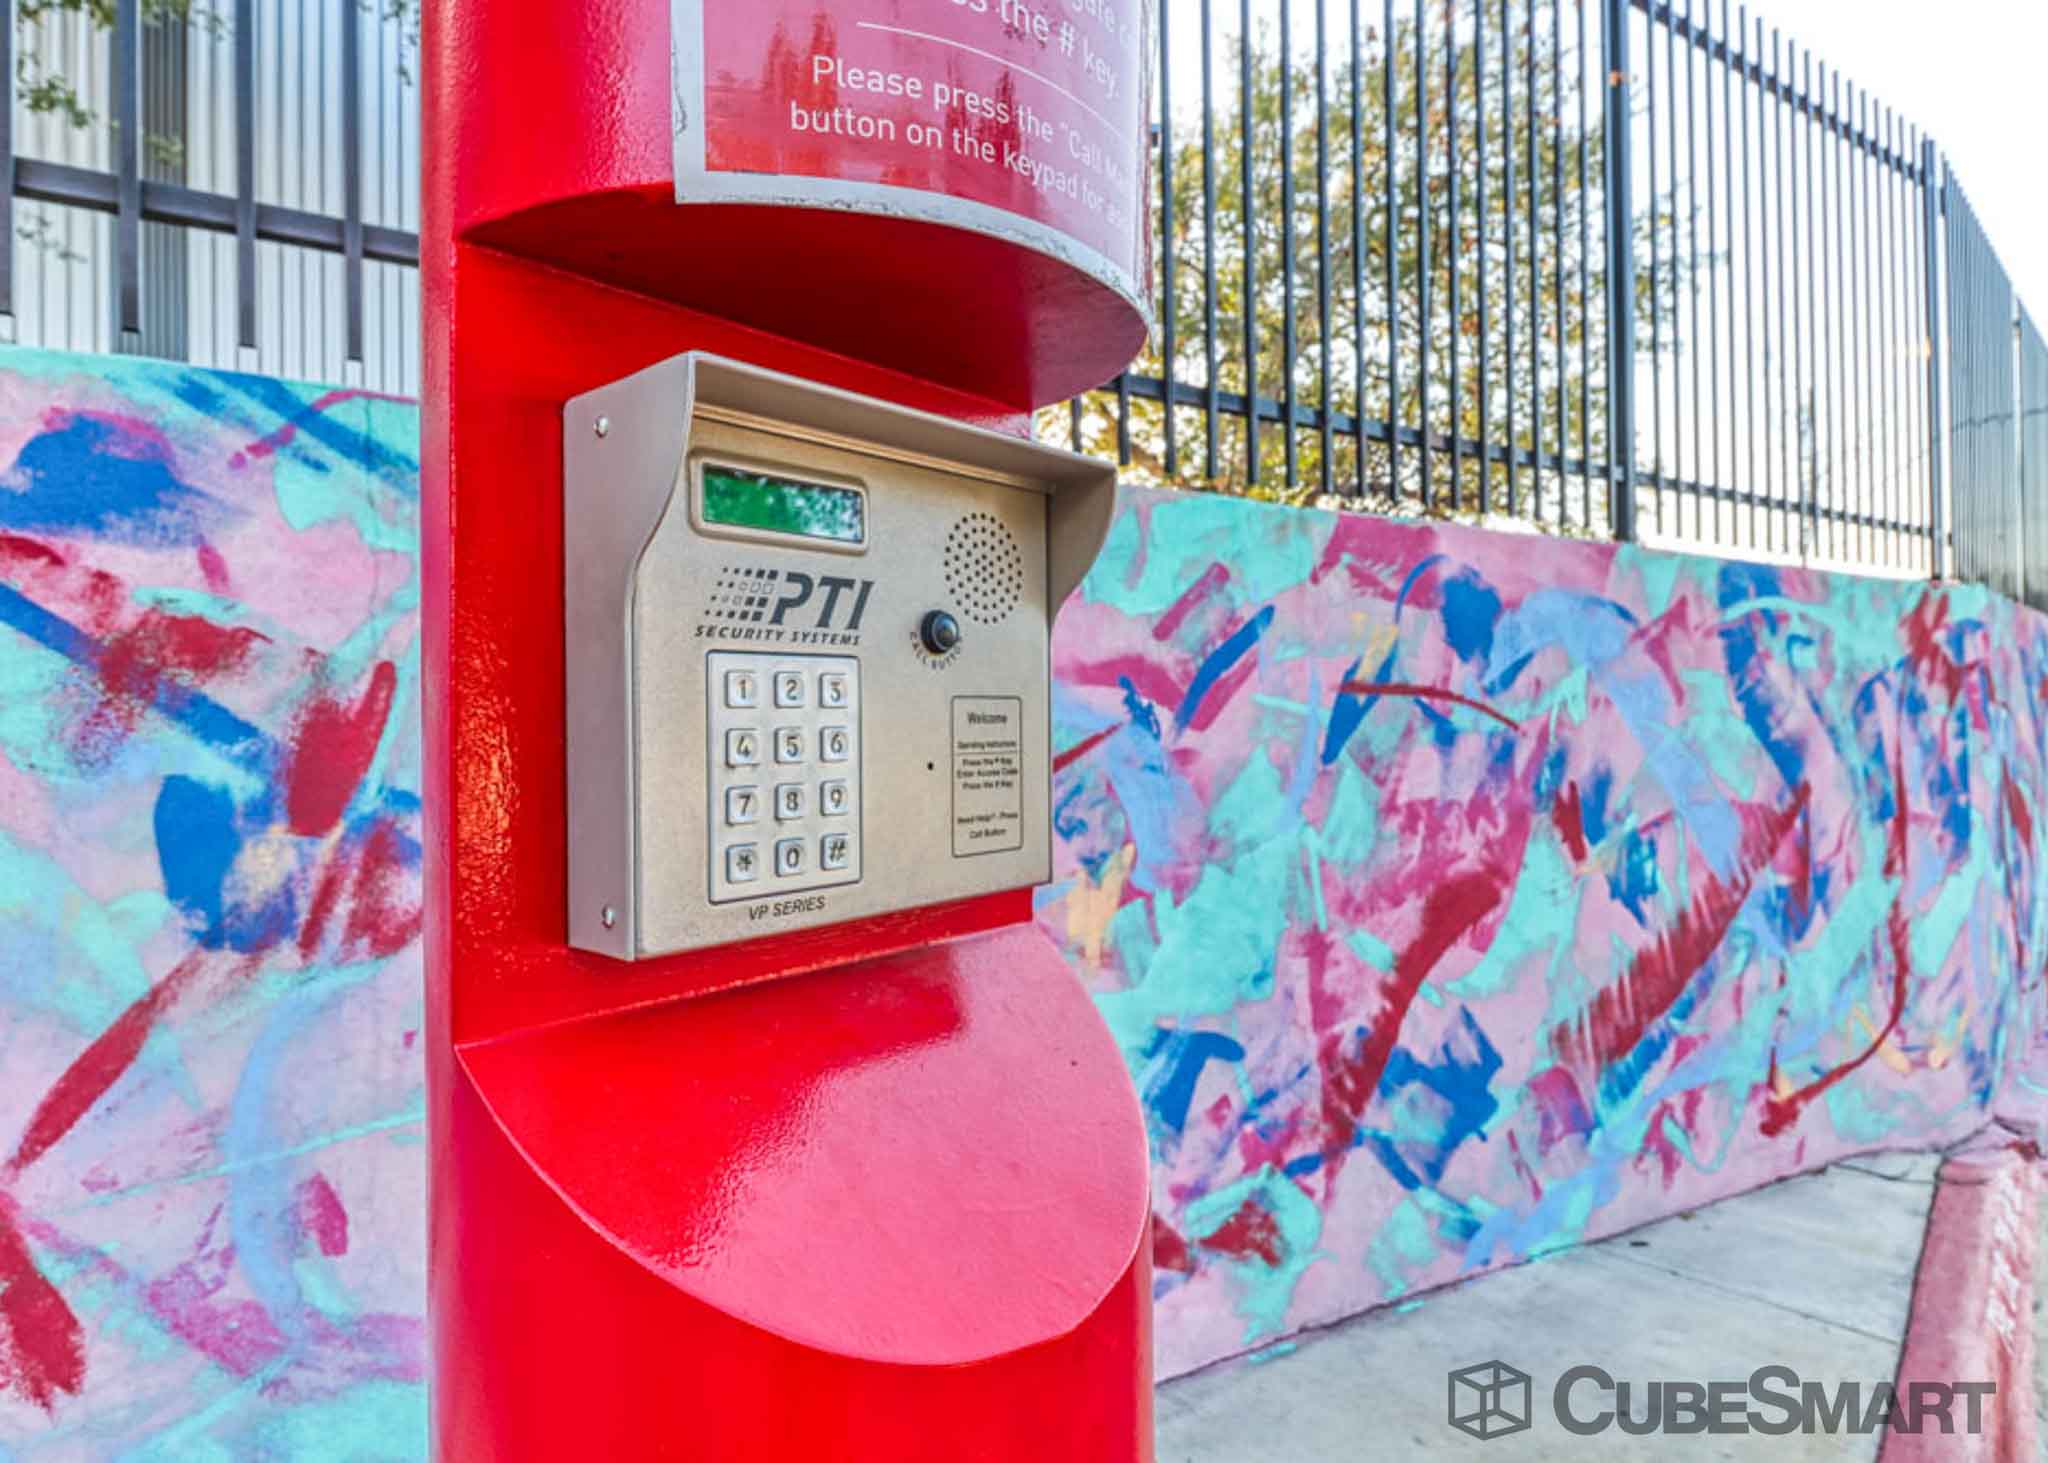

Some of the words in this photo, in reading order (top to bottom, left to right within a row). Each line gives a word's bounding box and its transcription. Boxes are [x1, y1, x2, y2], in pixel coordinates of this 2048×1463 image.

[812, 56, 922, 99] Please
[934, 82, 1010, 124] press
[1017, 104, 1054, 143] the
[790, 101, 895, 142] button
[906, 122, 943, 149] on
[952, 126, 996, 163] the
[1003, 141, 1079, 200] keypad
[769, 572, 875, 630] PTI
[695, 624, 784, 643] SECURITY
[791, 631, 861, 646] SYSTEMS
[737, 679, 748, 700] 1
[785, 679, 798, 701] 2
[829, 681, 841, 702] 3
[966, 712, 1008, 725] Welcome
[736, 735, 751, 758] 4
[786, 735, 799, 757] 5
[831, 732, 843, 754] 6
[737, 793, 752, 817] 7
[786, 791, 799, 812] 8
[830, 788, 842, 809] 9
[786, 847, 800, 869] 0
[828, 838, 846, 862] #
[749, 905, 769, 921] VP
[773, 895, 826, 918] SERIES
